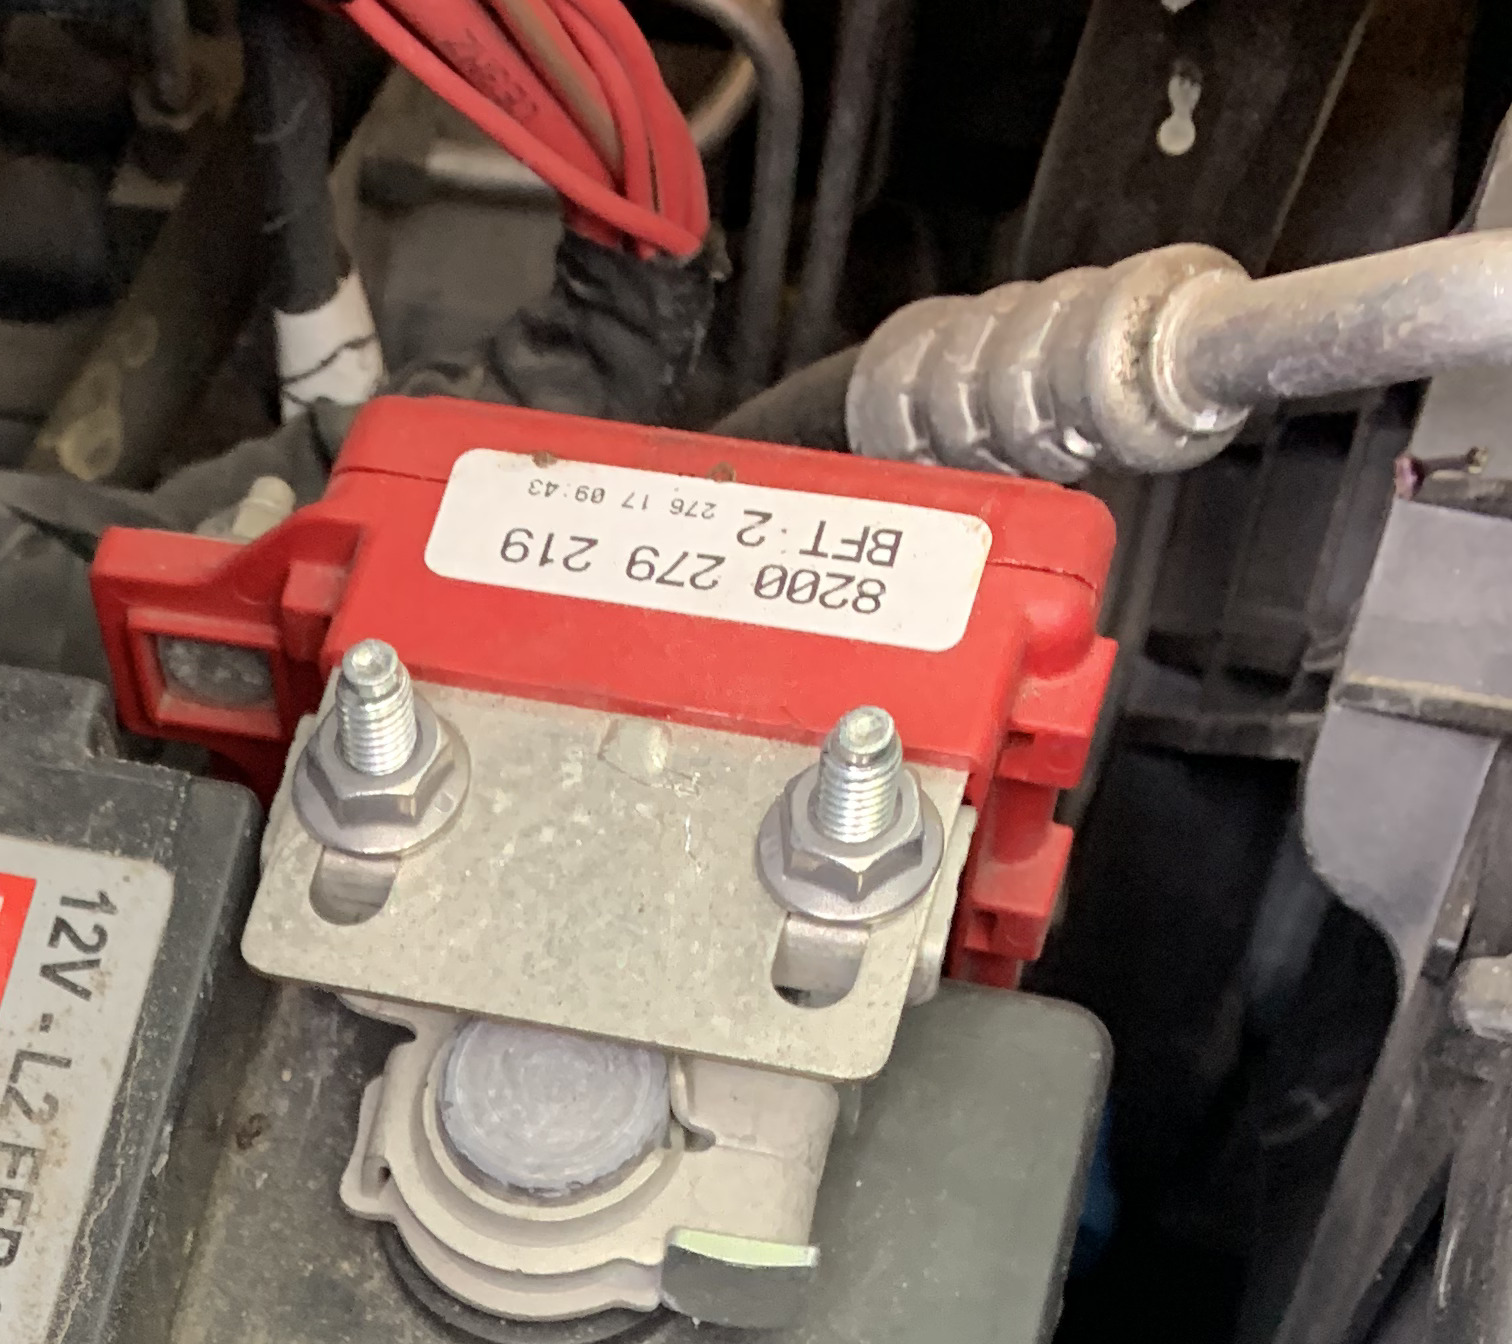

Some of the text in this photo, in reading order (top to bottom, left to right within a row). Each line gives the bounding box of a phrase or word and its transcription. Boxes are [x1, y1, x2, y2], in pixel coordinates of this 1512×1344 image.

[527, 477, 717, 520] 276 17 09:43
[500, 527, 888, 614] 8200 279 219
[39, 890, 117, 1001] 12V
[38, 1012, 54, 1033] -
